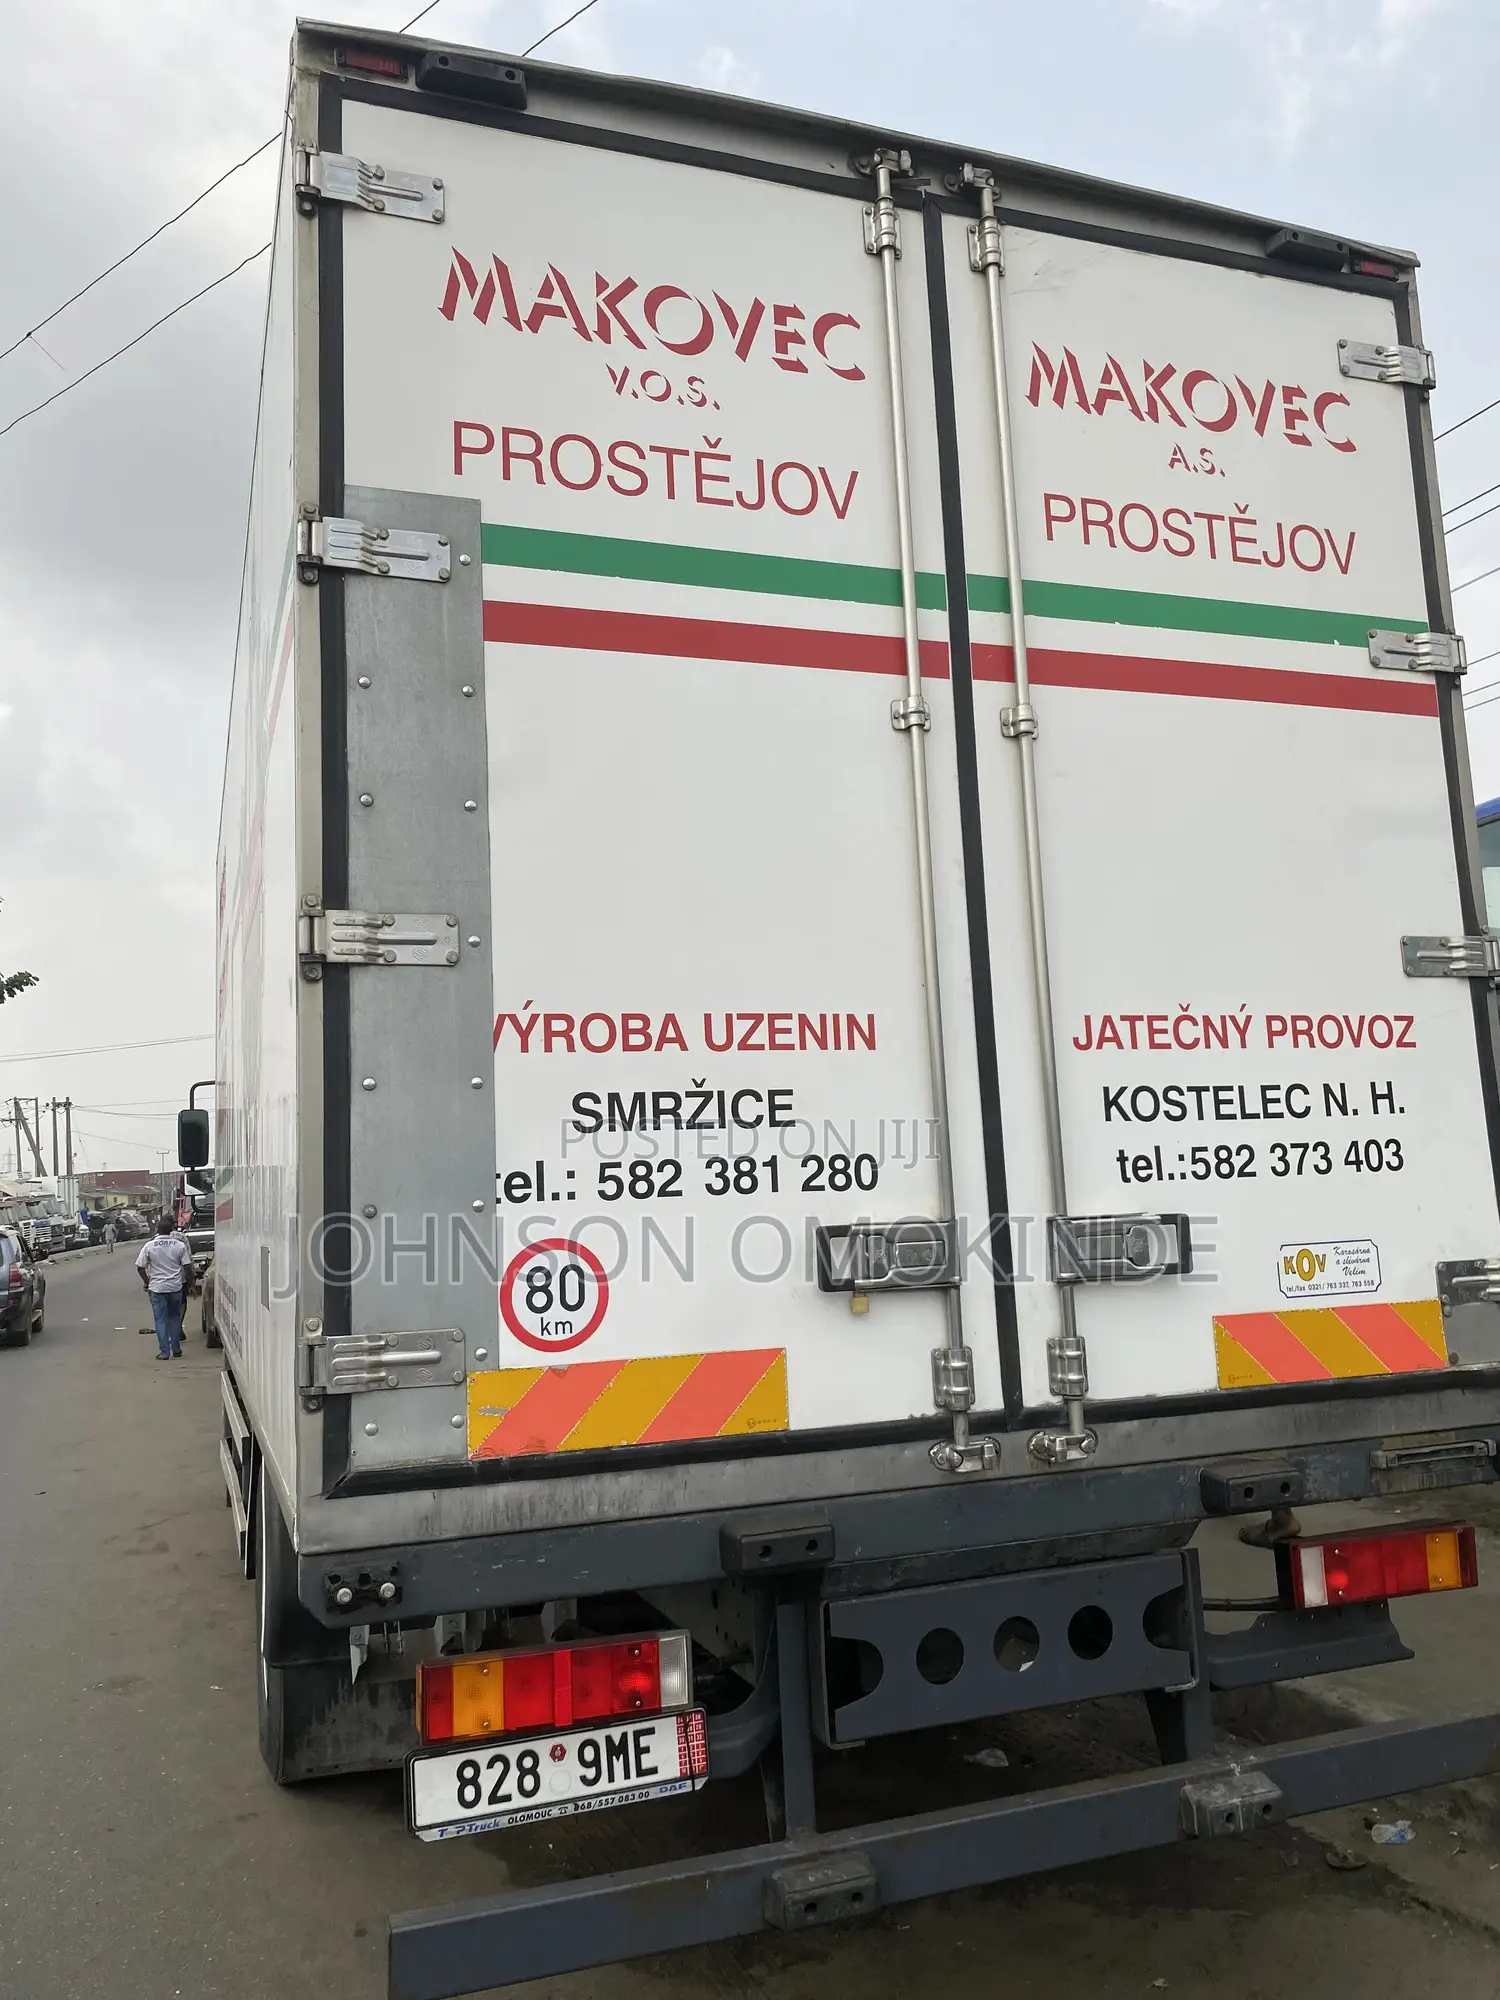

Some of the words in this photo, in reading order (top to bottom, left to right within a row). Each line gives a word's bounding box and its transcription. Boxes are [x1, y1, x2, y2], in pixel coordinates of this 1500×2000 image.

[438, 245, 866, 382] MAKOVEC
[605, 362, 721, 411] V.O.S.
[1025, 340, 1357, 453] MAKOVEC
[453, 420, 859, 520] PROSTĚJOV
[1168, 442, 1226, 478] A.S.
[1043, 492, 1356, 575] PROSTĚJOV
[703, 1013, 877, 1052] UZENIN
[1072, 1003, 1252, 1051] JATEČNÝ
[1265, 1014, 1417, 1050] PROVOZ
[571, 1077, 796, 1134] SMRŽICE
[1102, 1082, 1312, 1122] KOSTELEC
[1322, 1081, 1359, 1117] N.
[1369, 1080, 1405, 1115] H.
[598, 1158, 684, 1202] 582
[704, 1154, 780, 1196] 381
[800, 1152, 879, 1193] 280
[1268, 1140, 1333, 1177] 373
[1343, 1138, 1404, 1173] 403
[525, 1264, 587, 1314] 80
[1283, 1248, 1327, 1281] KOV
[540, 1316, 573, 1337] km
[456, 1749, 541, 1809] 828
[577, 1726, 659, 1787] 9ME
[507, 1809, 553, 1825] OLOMOUC
[659, 1782, 687, 1794] DAF
